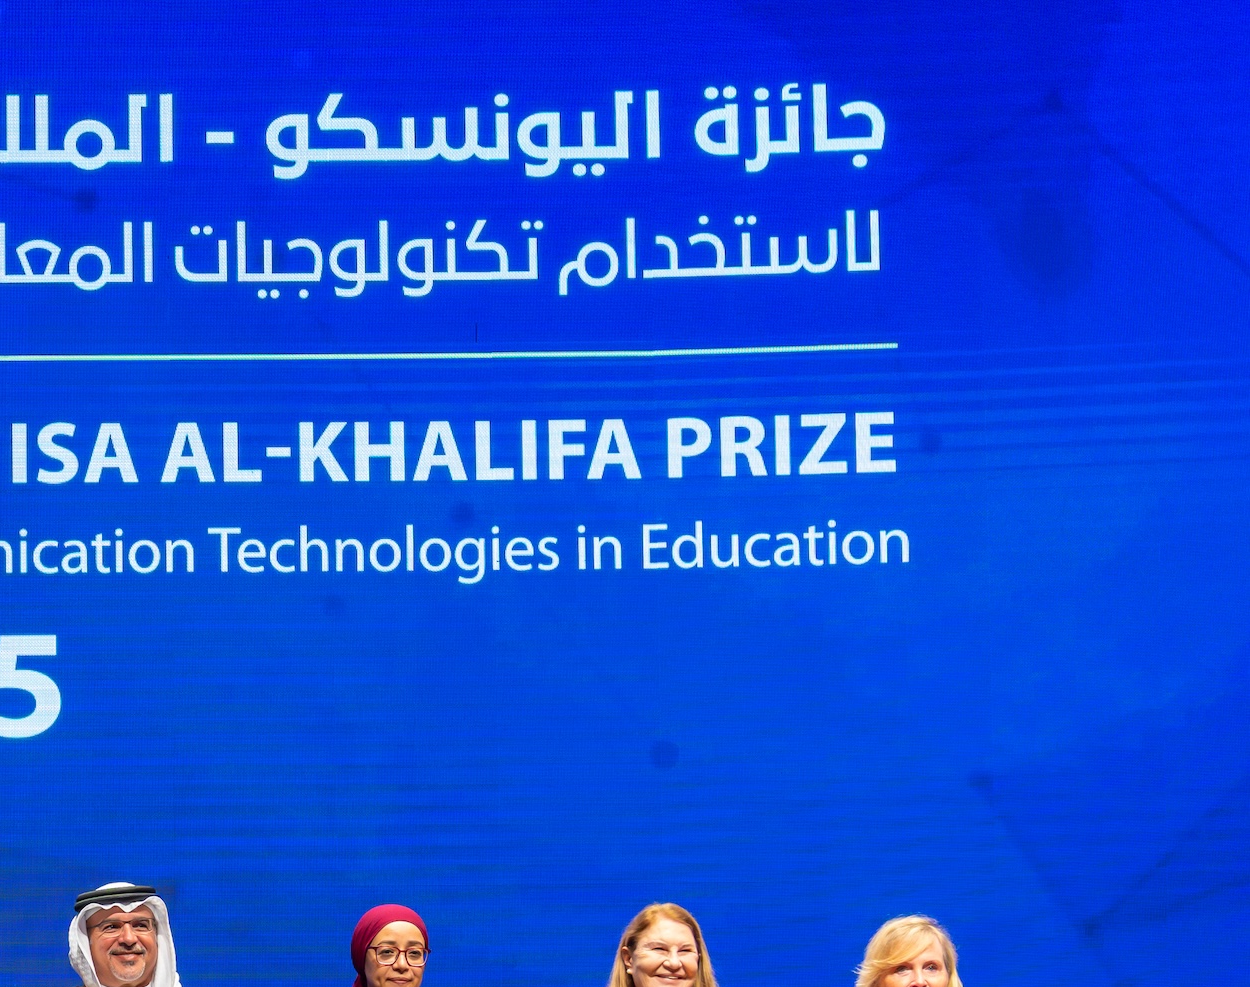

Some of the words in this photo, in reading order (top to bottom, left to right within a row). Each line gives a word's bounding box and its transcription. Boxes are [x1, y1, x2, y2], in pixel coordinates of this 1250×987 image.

[205, 131, 234, 144] -
[265, 86, 661, 180] اليونسكو
[695, 82, 886, 173] جائزة
[174, 219, 544, 299] تكنولوجيات
[558, 209, 881, 296] لاستخدام
[11, 422, 139, 485] ISA
[160, 418, 642, 483] AL-KHALIFA
[667, 411, 897, 479] PRIZE
[207, 524, 560, 585] Technologies
[577, 524, 622, 570] in
[642, 519, 910, 570] Education
